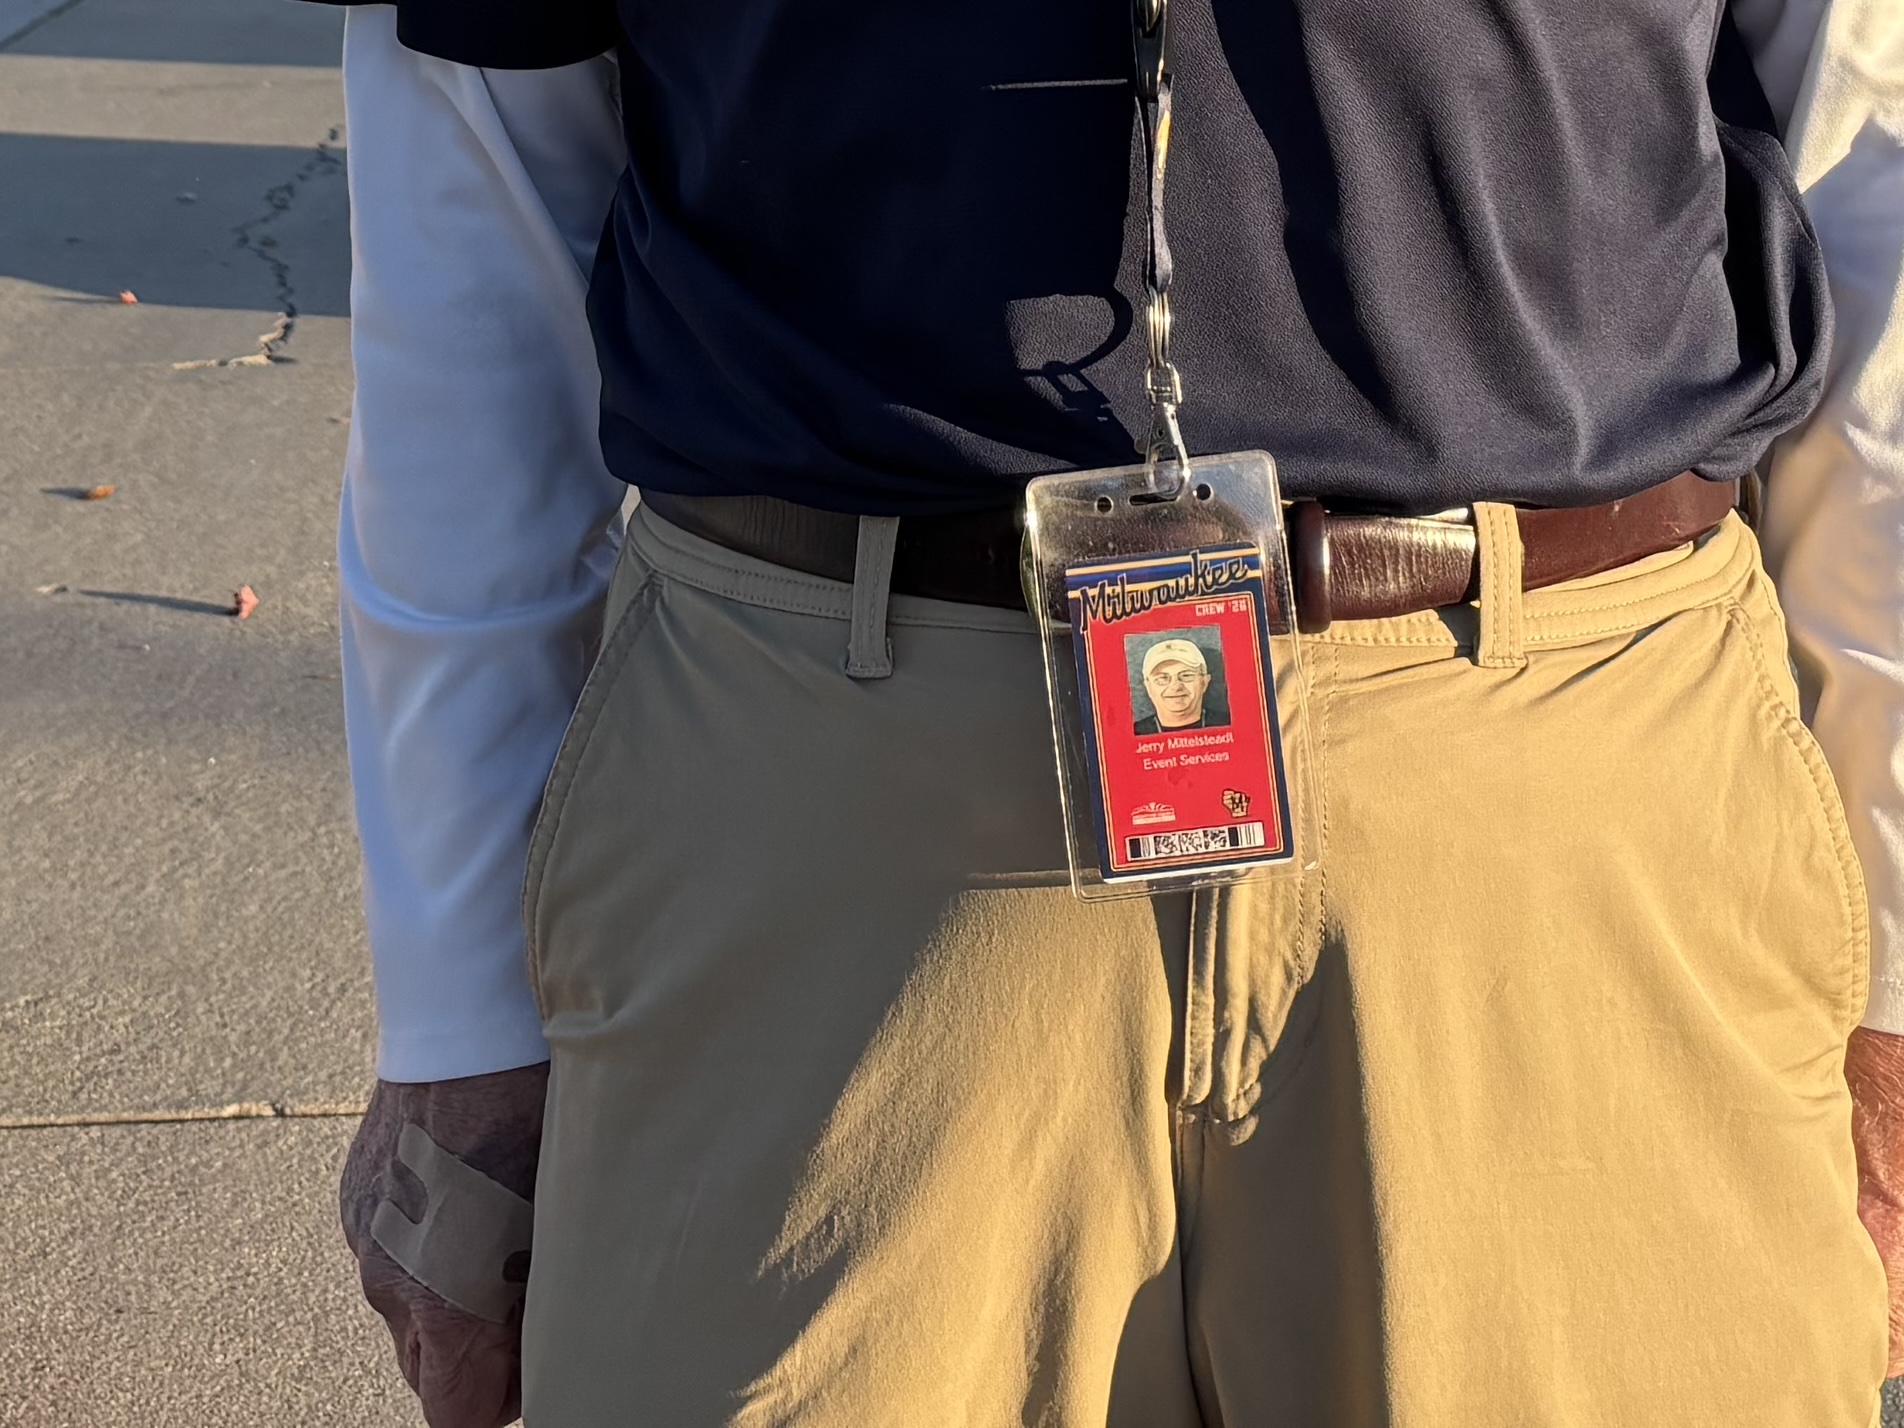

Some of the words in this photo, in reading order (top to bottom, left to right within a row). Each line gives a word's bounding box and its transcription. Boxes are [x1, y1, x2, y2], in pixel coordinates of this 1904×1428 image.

[1079, 549, 1249, 635] Milwaukee
[1195, 601, 1225, 617] CREW
[1136, 742, 1165, 754] Jerry
[1143, 757, 1178, 771] Event
[1179, 751, 1230, 766] Services
